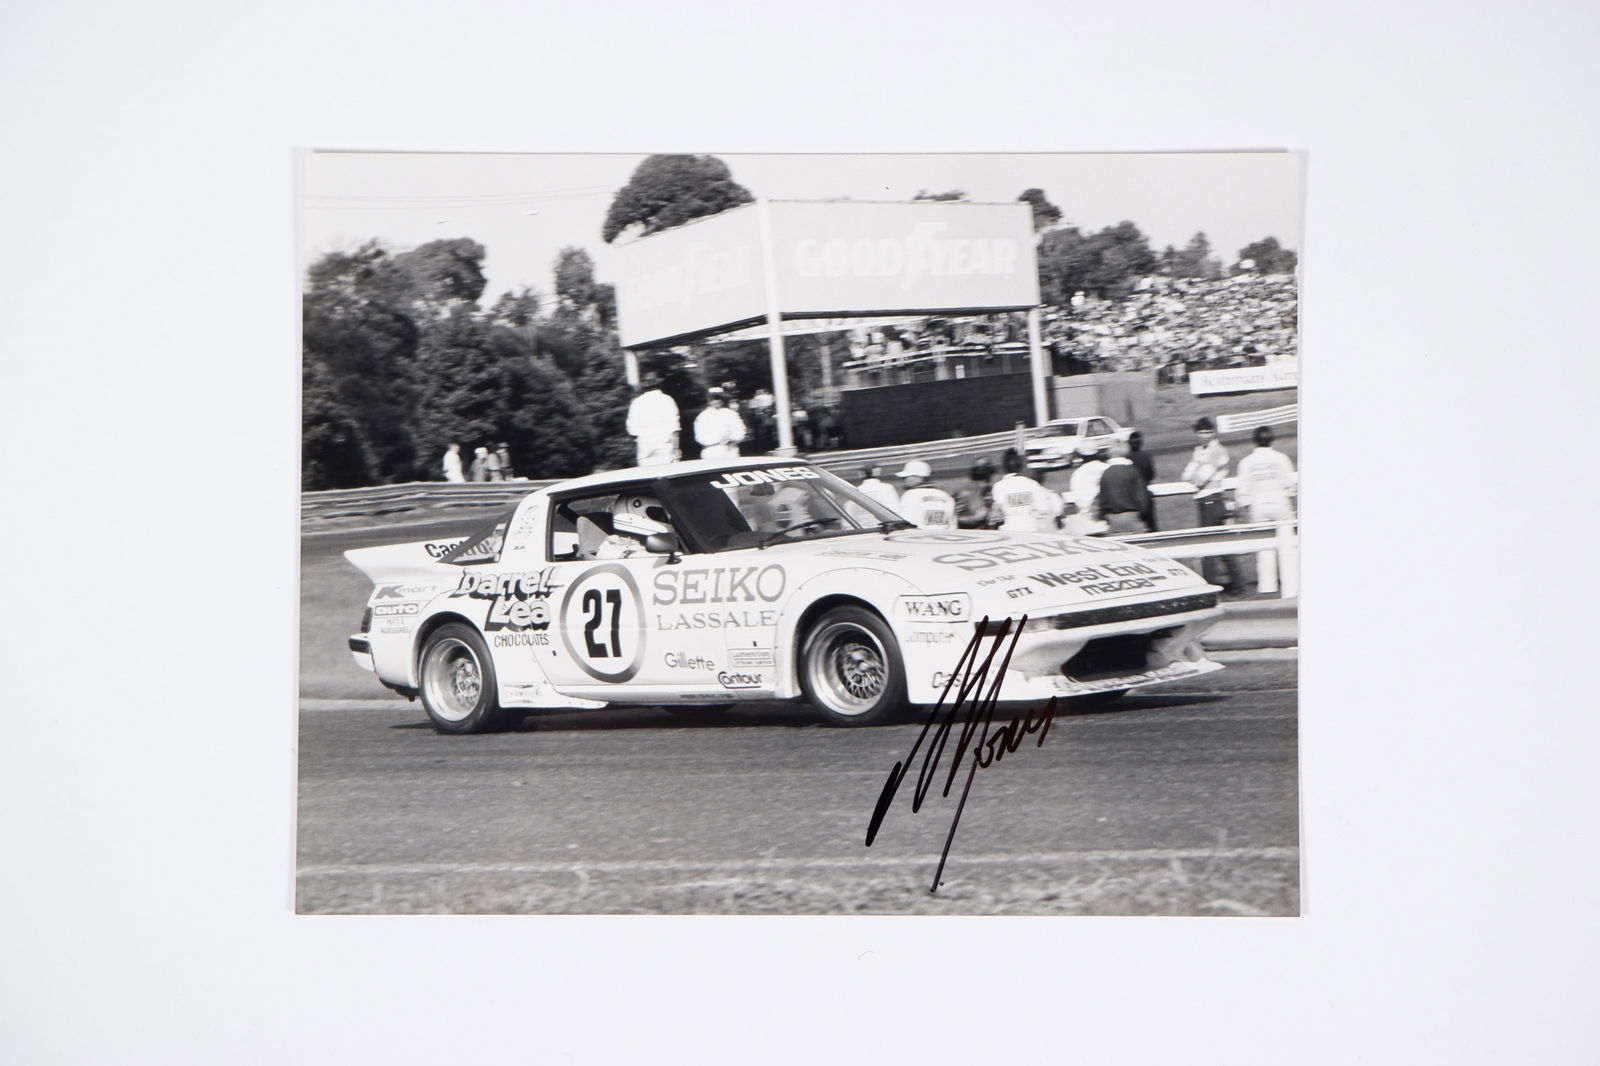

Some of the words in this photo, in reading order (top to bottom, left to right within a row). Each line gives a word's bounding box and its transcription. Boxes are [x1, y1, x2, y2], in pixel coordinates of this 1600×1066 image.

[794, 225, 1018, 287] GOODYEAR
[710, 466, 821, 489] JONES
[934, 537, 1130, 571] SEIKO
[653, 564, 785, 606] SEIKO
[1027, 567, 1110, 588] West
[1100, 562, 1158, 577] End
[484, 596, 551, 632] Lea
[904, 600, 961, 616] WANG
[582, 588, 623, 658] 27
[656, 611, 776, 630] LASSALE
[494, 633, 549, 648] CHOCOLATES
[664, 652, 715, 671] Gillette
[718, 671, 762, 690] Contour
